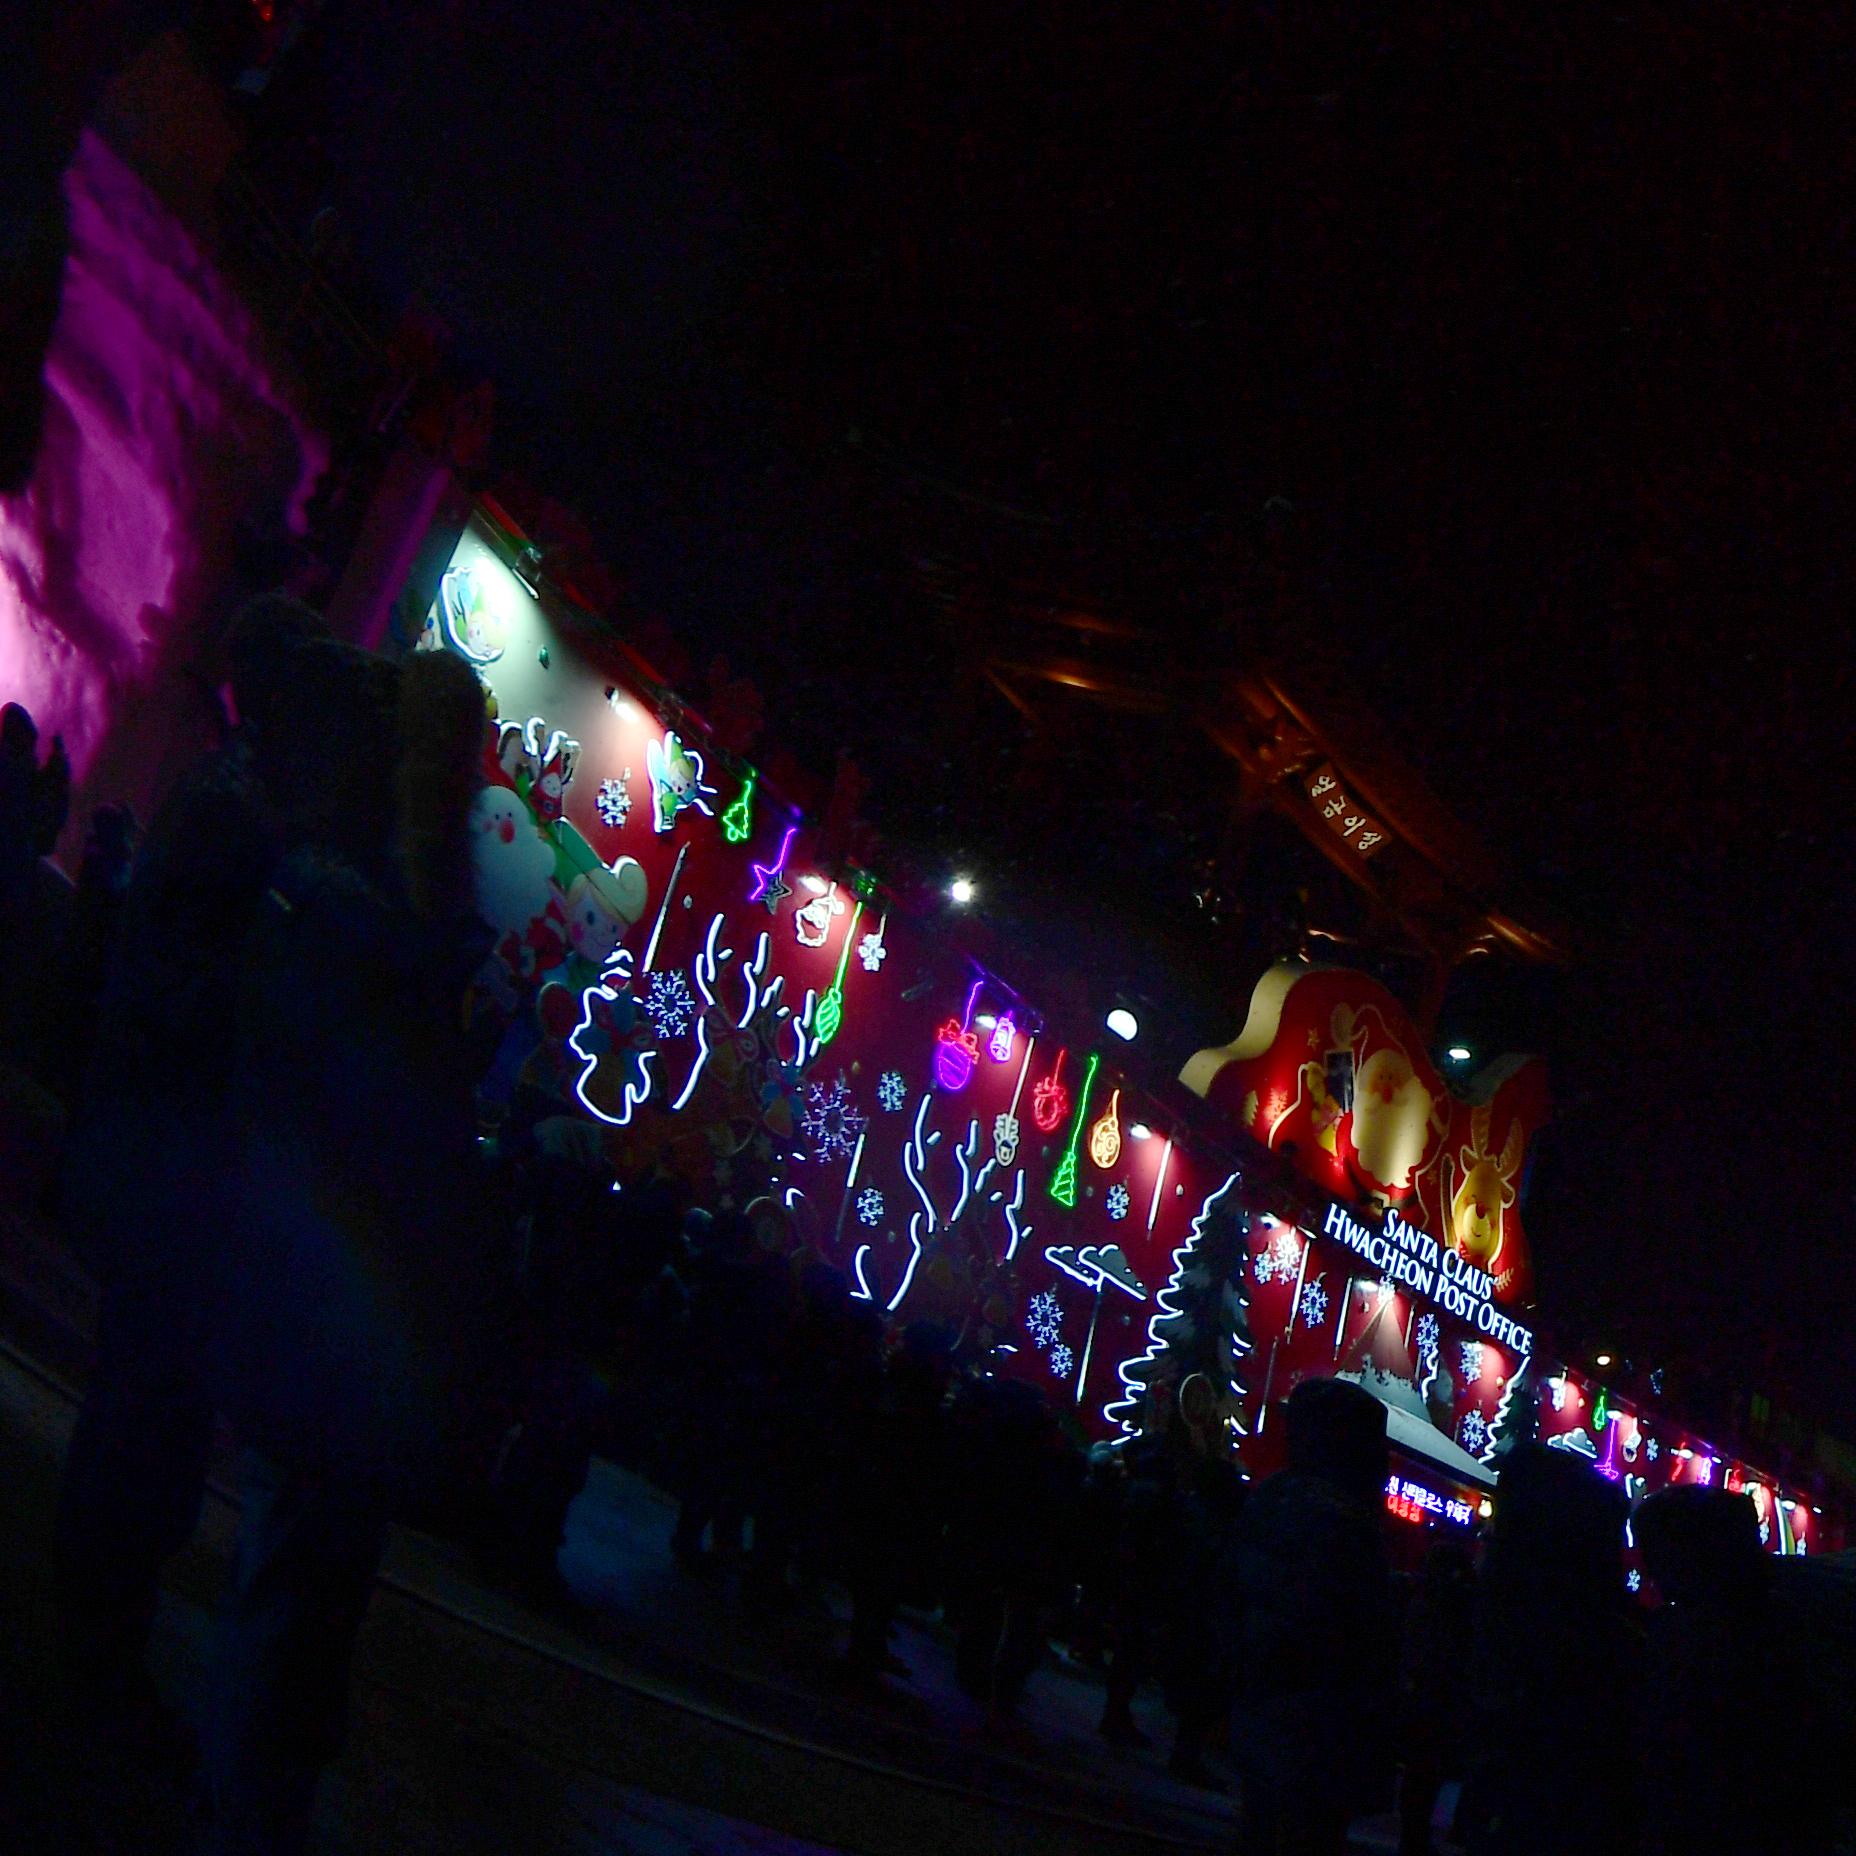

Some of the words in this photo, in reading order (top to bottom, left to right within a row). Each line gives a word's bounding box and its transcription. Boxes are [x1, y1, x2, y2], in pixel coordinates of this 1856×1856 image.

[1323, 1202, 1434, 1295] HWACHEON
[1434, 1274, 1479, 1323] POST
[1478, 1302, 1533, 1355] OFFICE
[1383, 1208, 1438, 1268] SANTA
